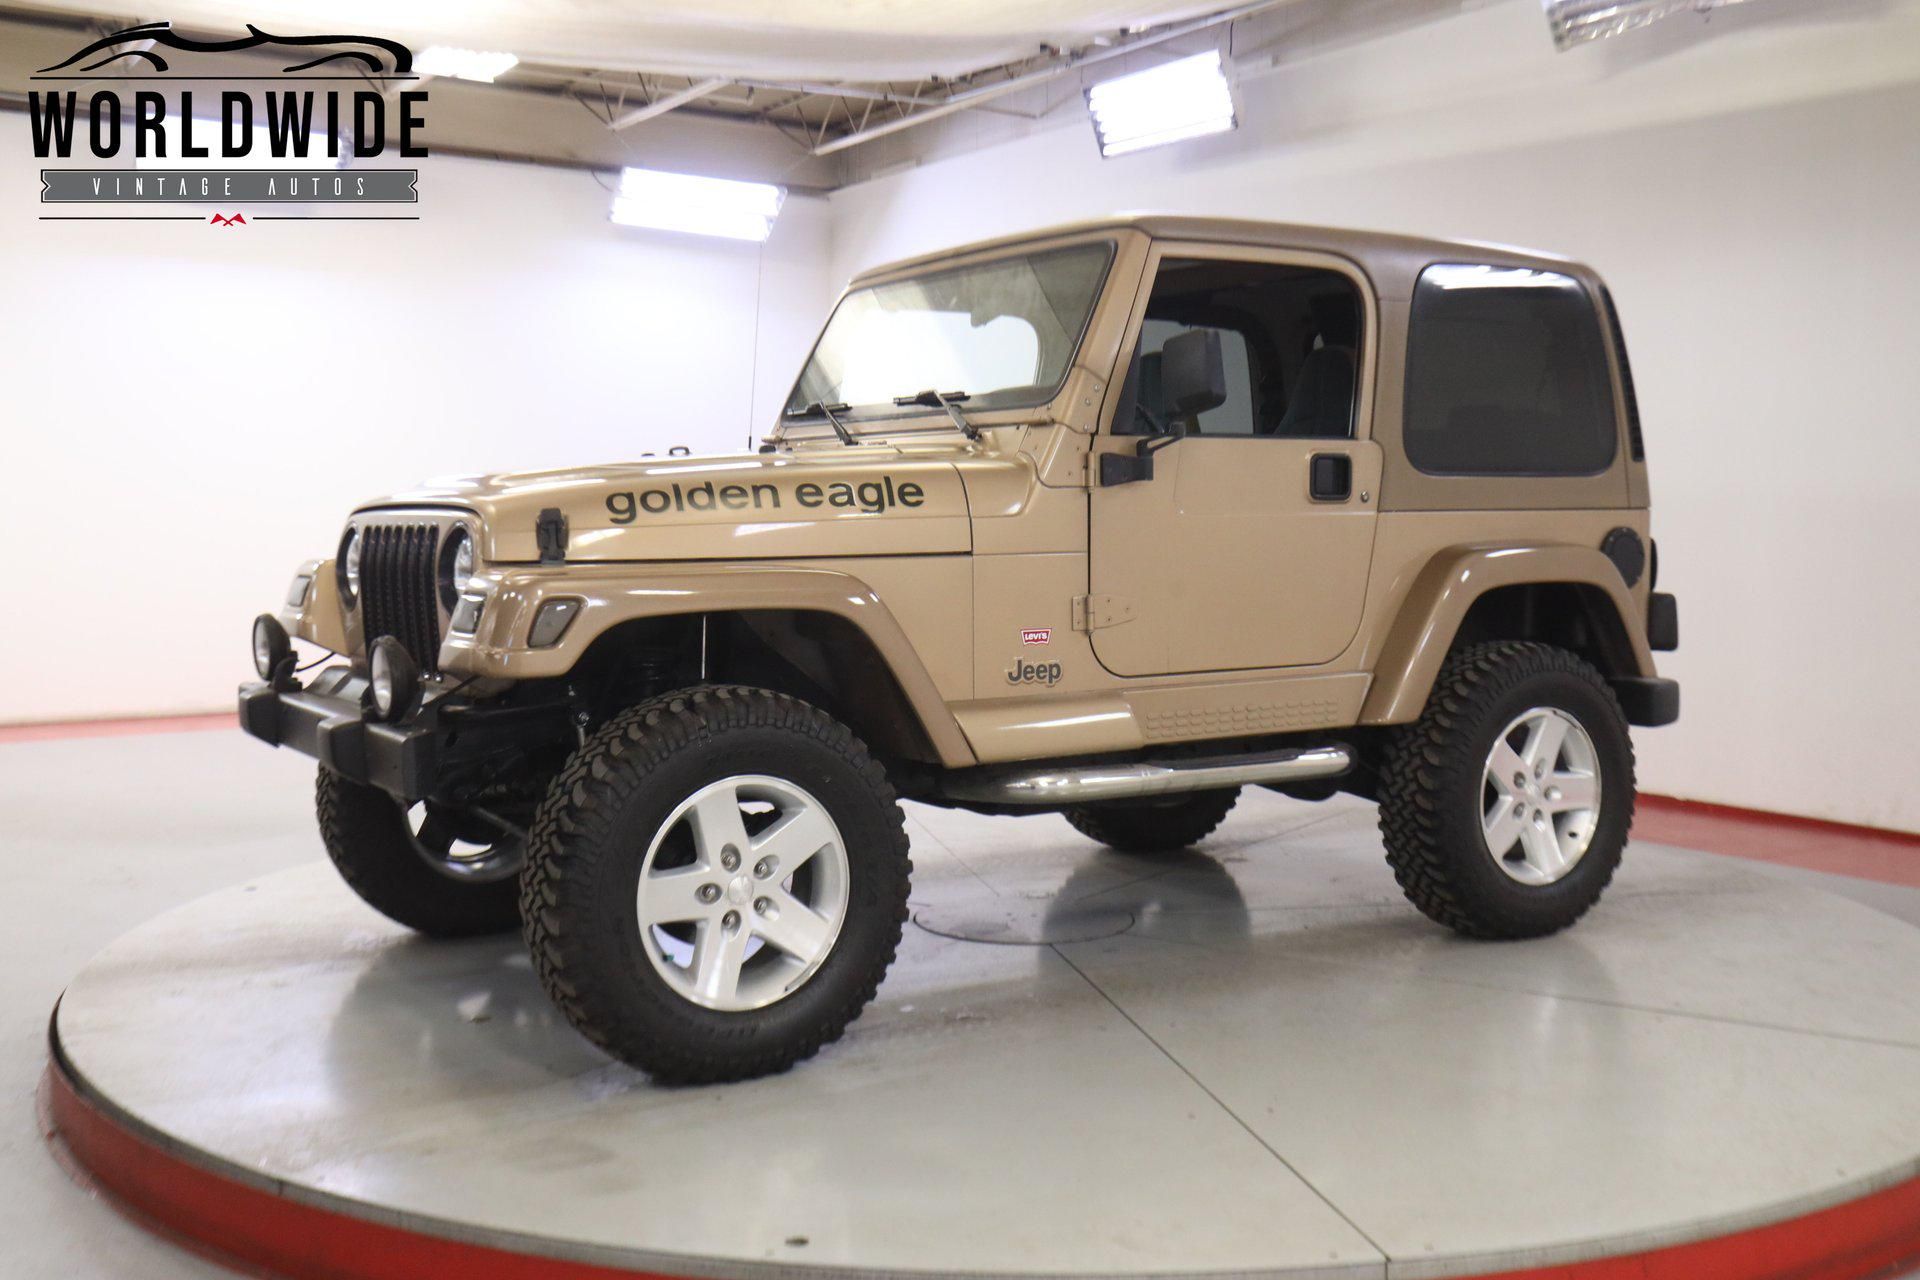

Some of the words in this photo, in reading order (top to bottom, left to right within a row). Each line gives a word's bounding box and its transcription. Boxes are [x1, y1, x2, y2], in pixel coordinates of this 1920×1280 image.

[605, 481, 782, 525] golden
[795, 476, 925, 514] eagle
[1007, 659, 1062, 685] Jeep
